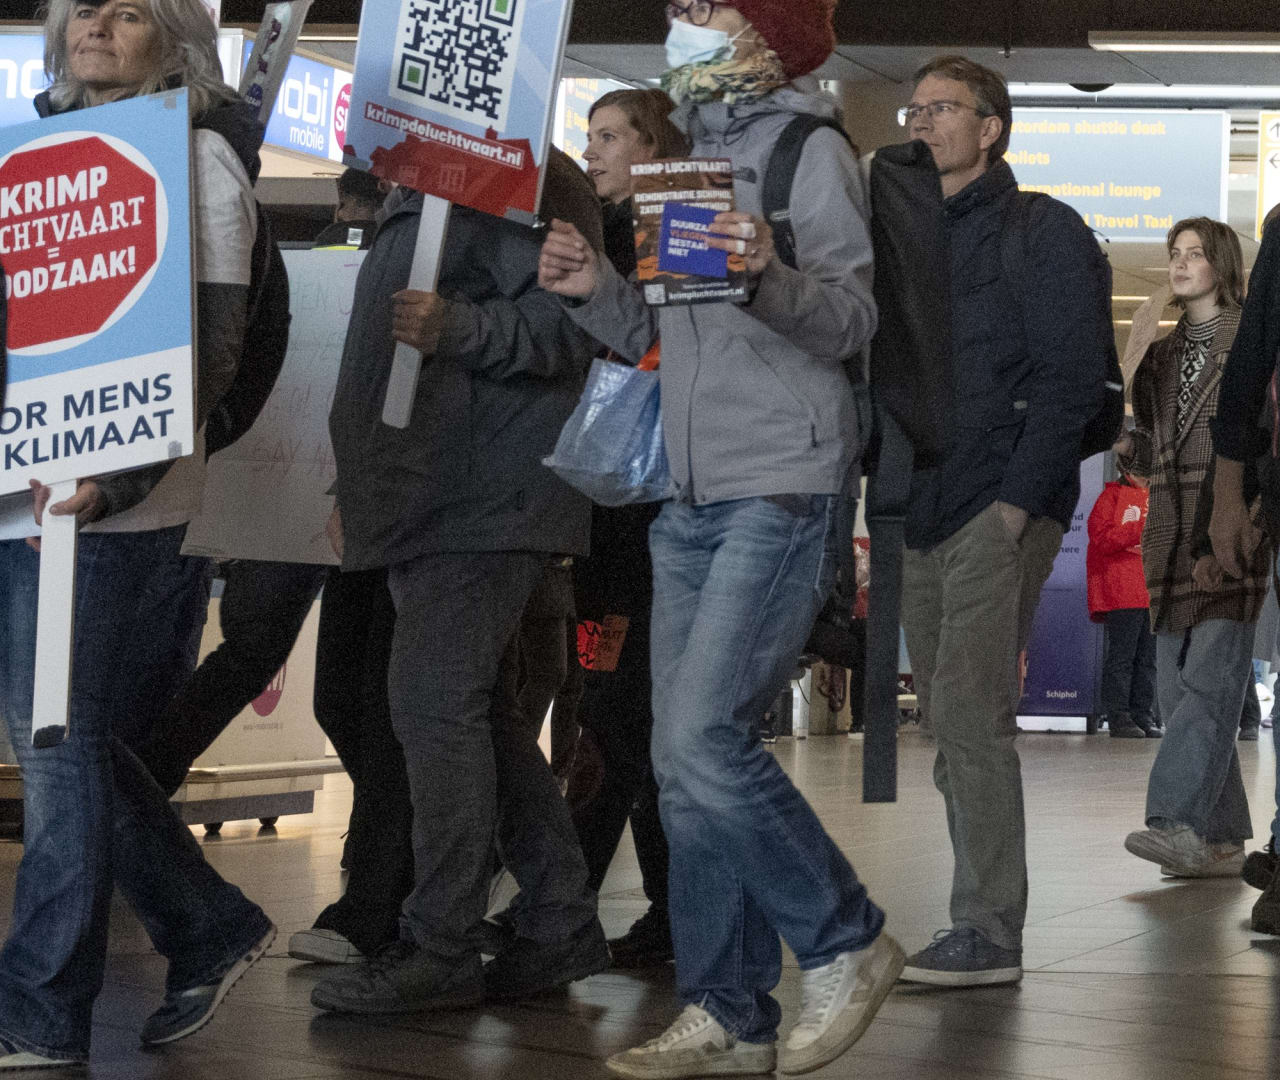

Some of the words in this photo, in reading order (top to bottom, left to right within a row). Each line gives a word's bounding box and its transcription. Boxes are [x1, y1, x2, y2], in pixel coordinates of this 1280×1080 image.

[289, 126, 325, 151] mobile
[367, 104, 522, 167] krimpdeluchtvaart.nl
[0, 166, 108, 219] KRIMP
[63, 373, 173, 422] MENS
[4, 408, 175, 470] KLIMAAT
[1046, 690, 1077, 700] Schiphol
